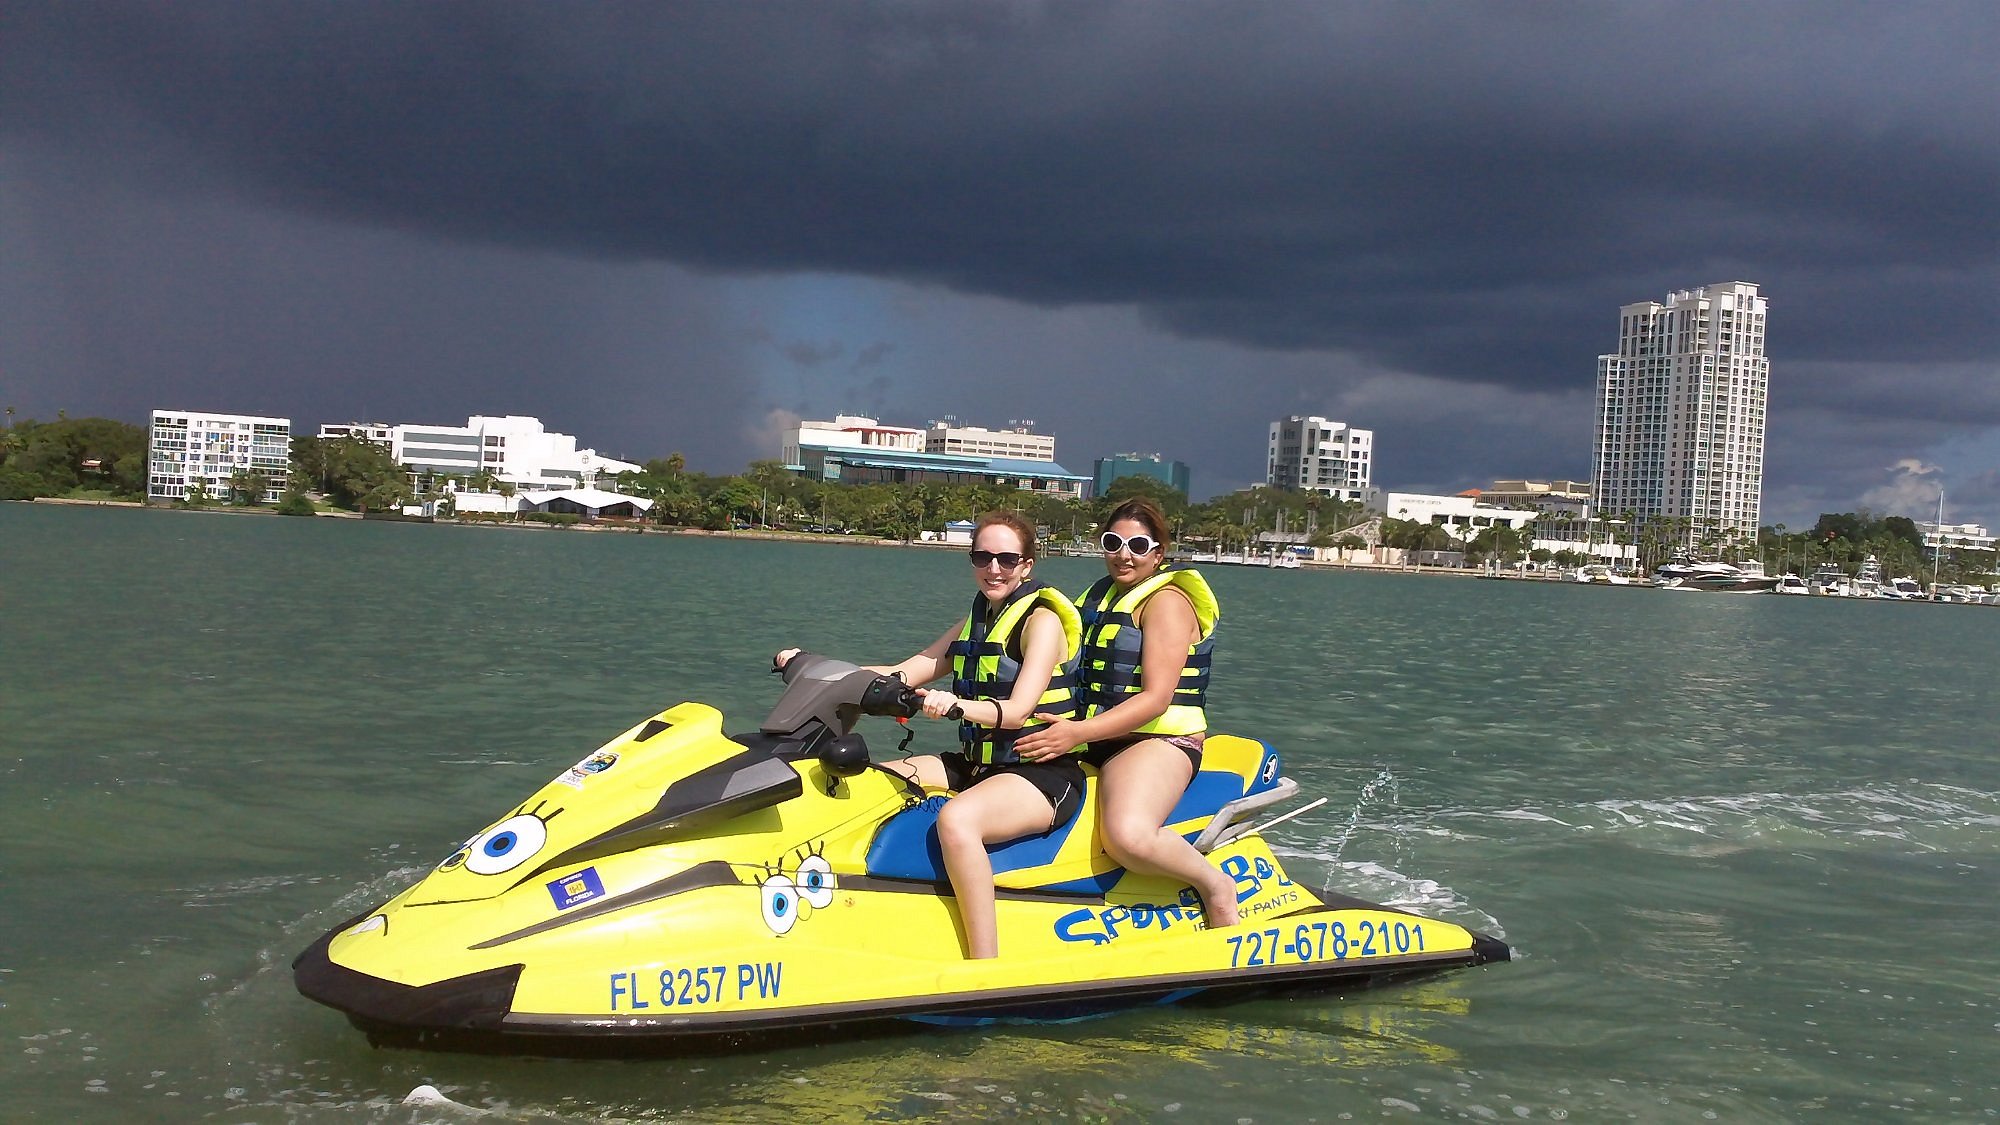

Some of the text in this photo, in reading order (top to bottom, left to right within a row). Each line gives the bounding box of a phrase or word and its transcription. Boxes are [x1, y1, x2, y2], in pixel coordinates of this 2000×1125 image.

[1253, 890, 1299, 915] PANTS
[1226, 920, 1425, 968] 727-678-2101
[610, 961, 782, 1011] FL 8257 PW
